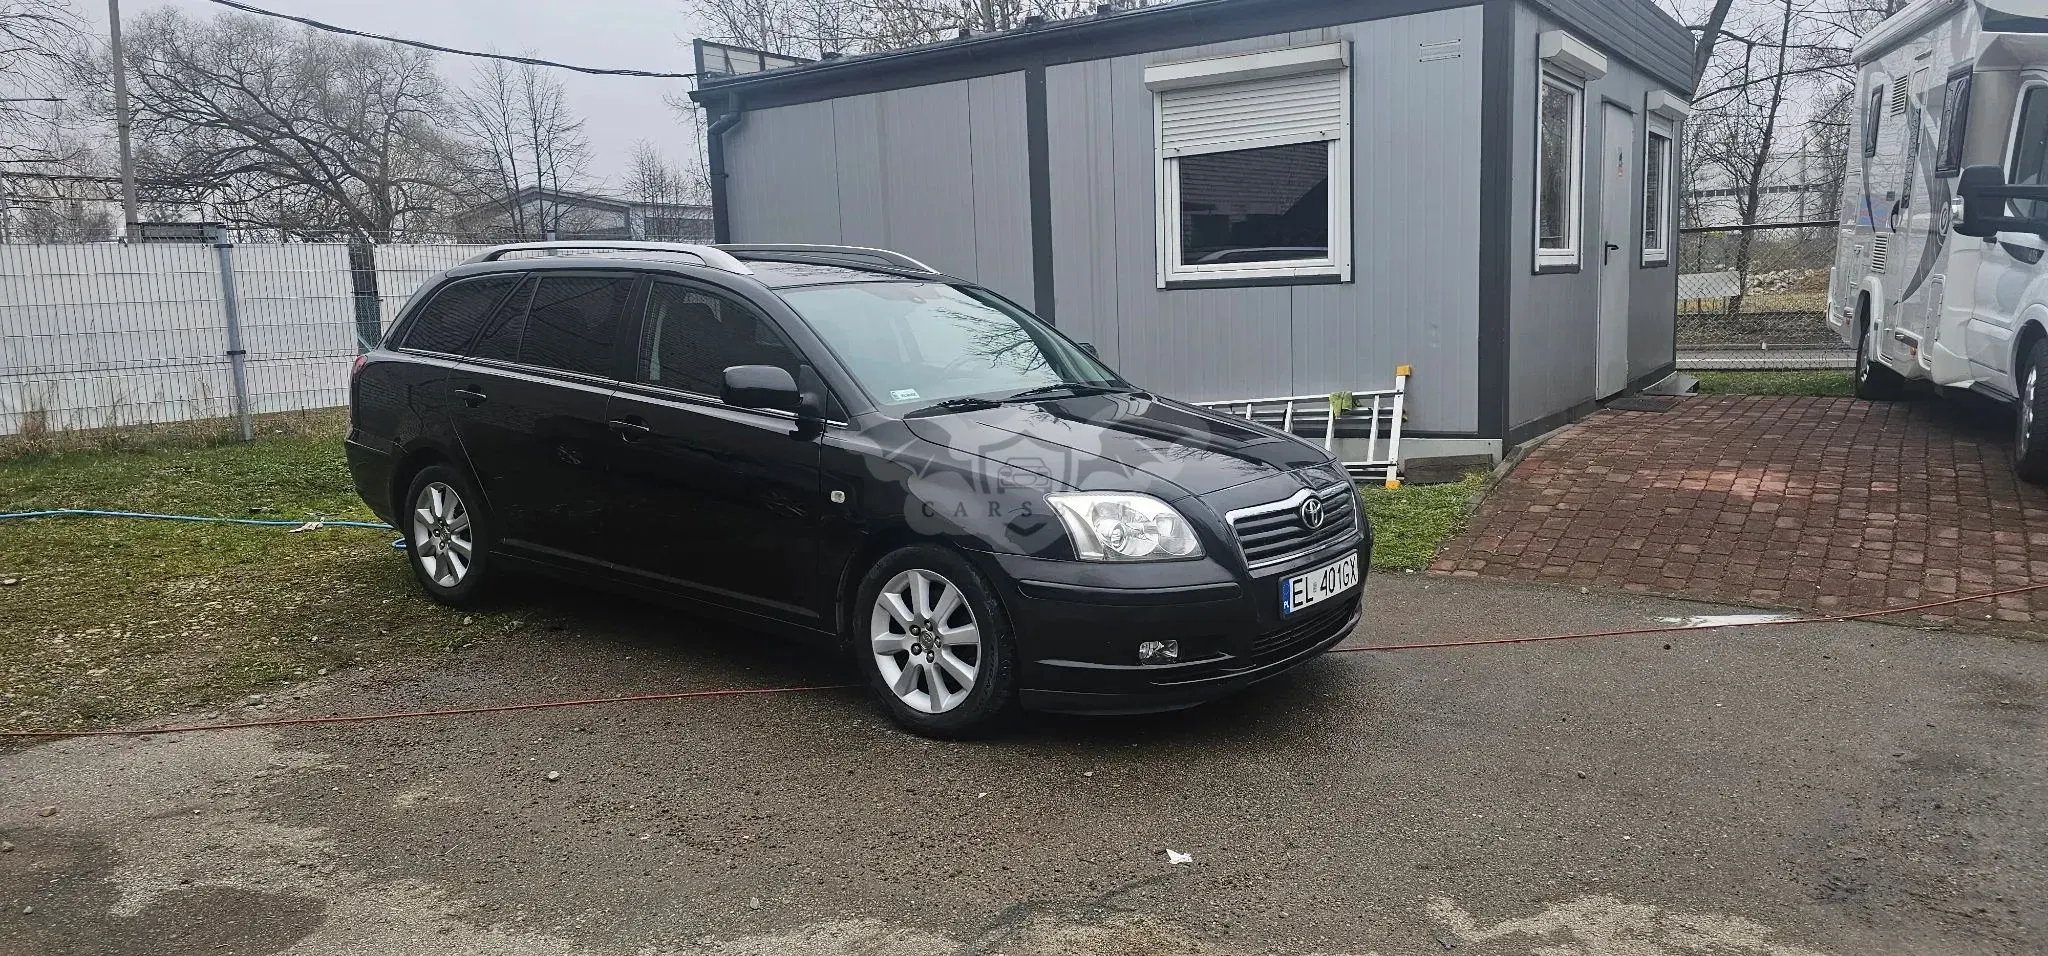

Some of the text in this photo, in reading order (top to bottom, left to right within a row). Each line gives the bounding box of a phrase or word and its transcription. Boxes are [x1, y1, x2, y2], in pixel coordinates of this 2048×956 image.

[1292, 555, 1357, 608] EL 401GX
[1283, 600, 1290, 609] PL
